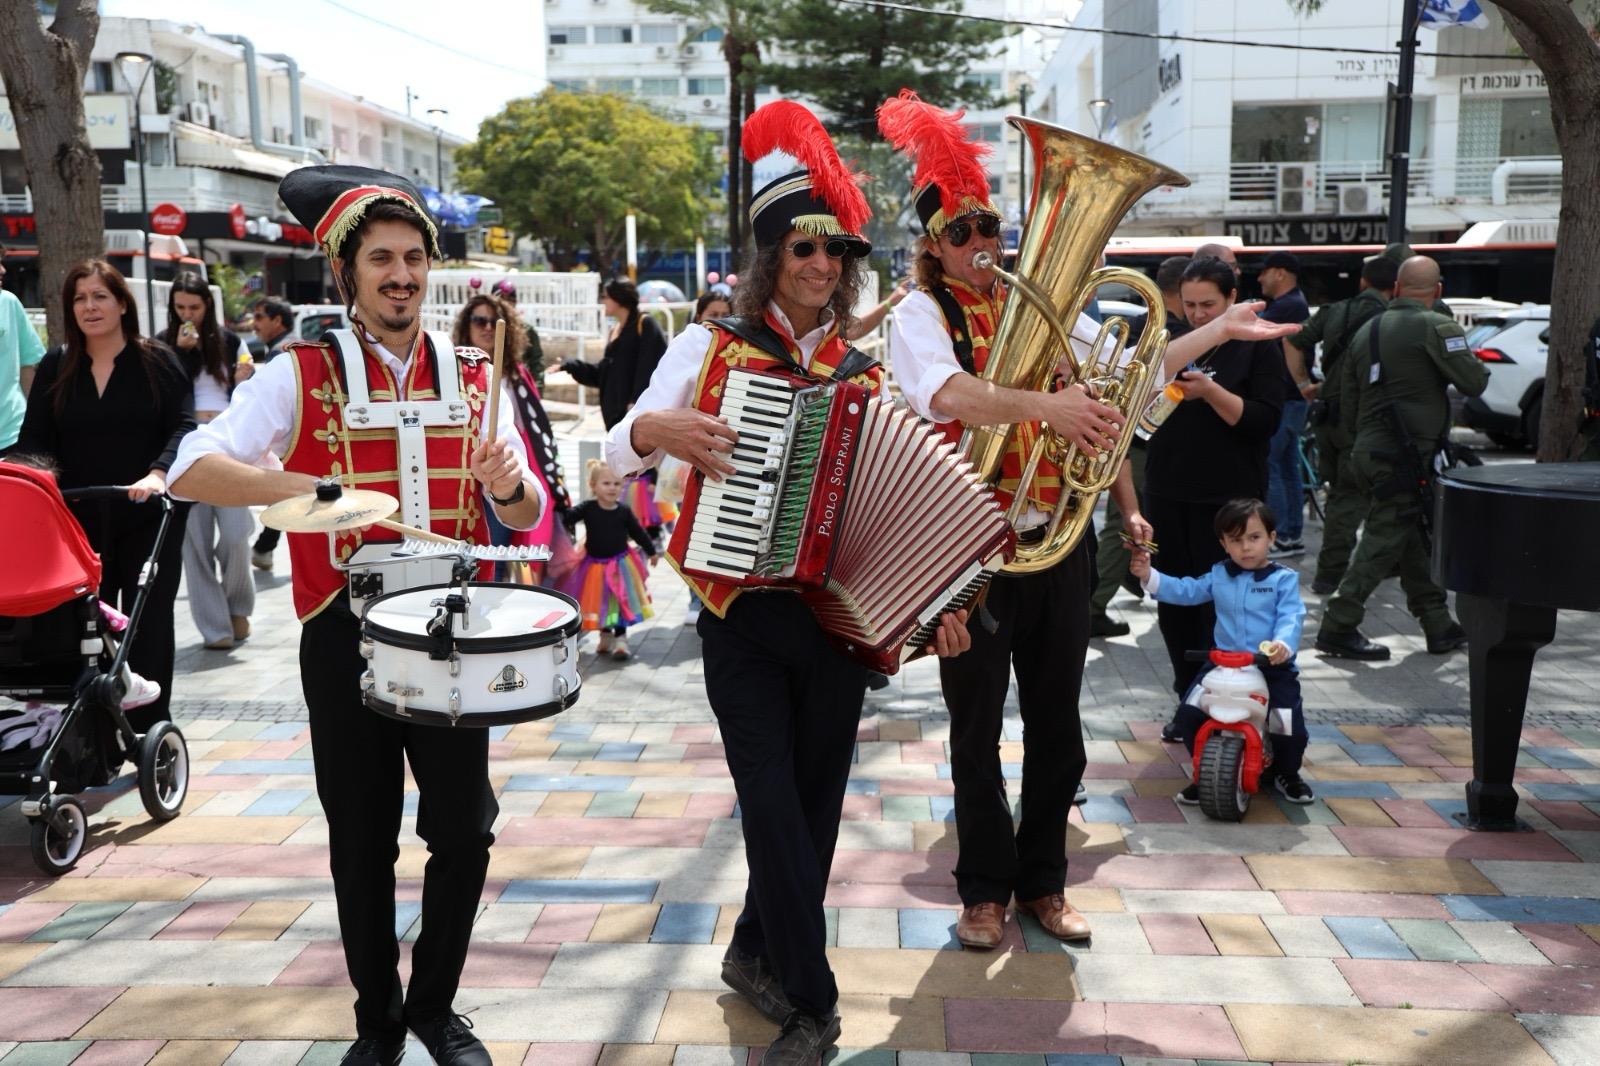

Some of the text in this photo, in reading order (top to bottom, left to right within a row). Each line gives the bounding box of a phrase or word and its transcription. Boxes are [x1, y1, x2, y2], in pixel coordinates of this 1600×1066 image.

[1336, 58, 1399, 73] ורין צחר
[1460, 73, 1548, 94] שרד עורכות דין
[1302, 221, 1388, 242] תכשיטי
[818, 427, 853, 537] PAOLO SOPRANI
